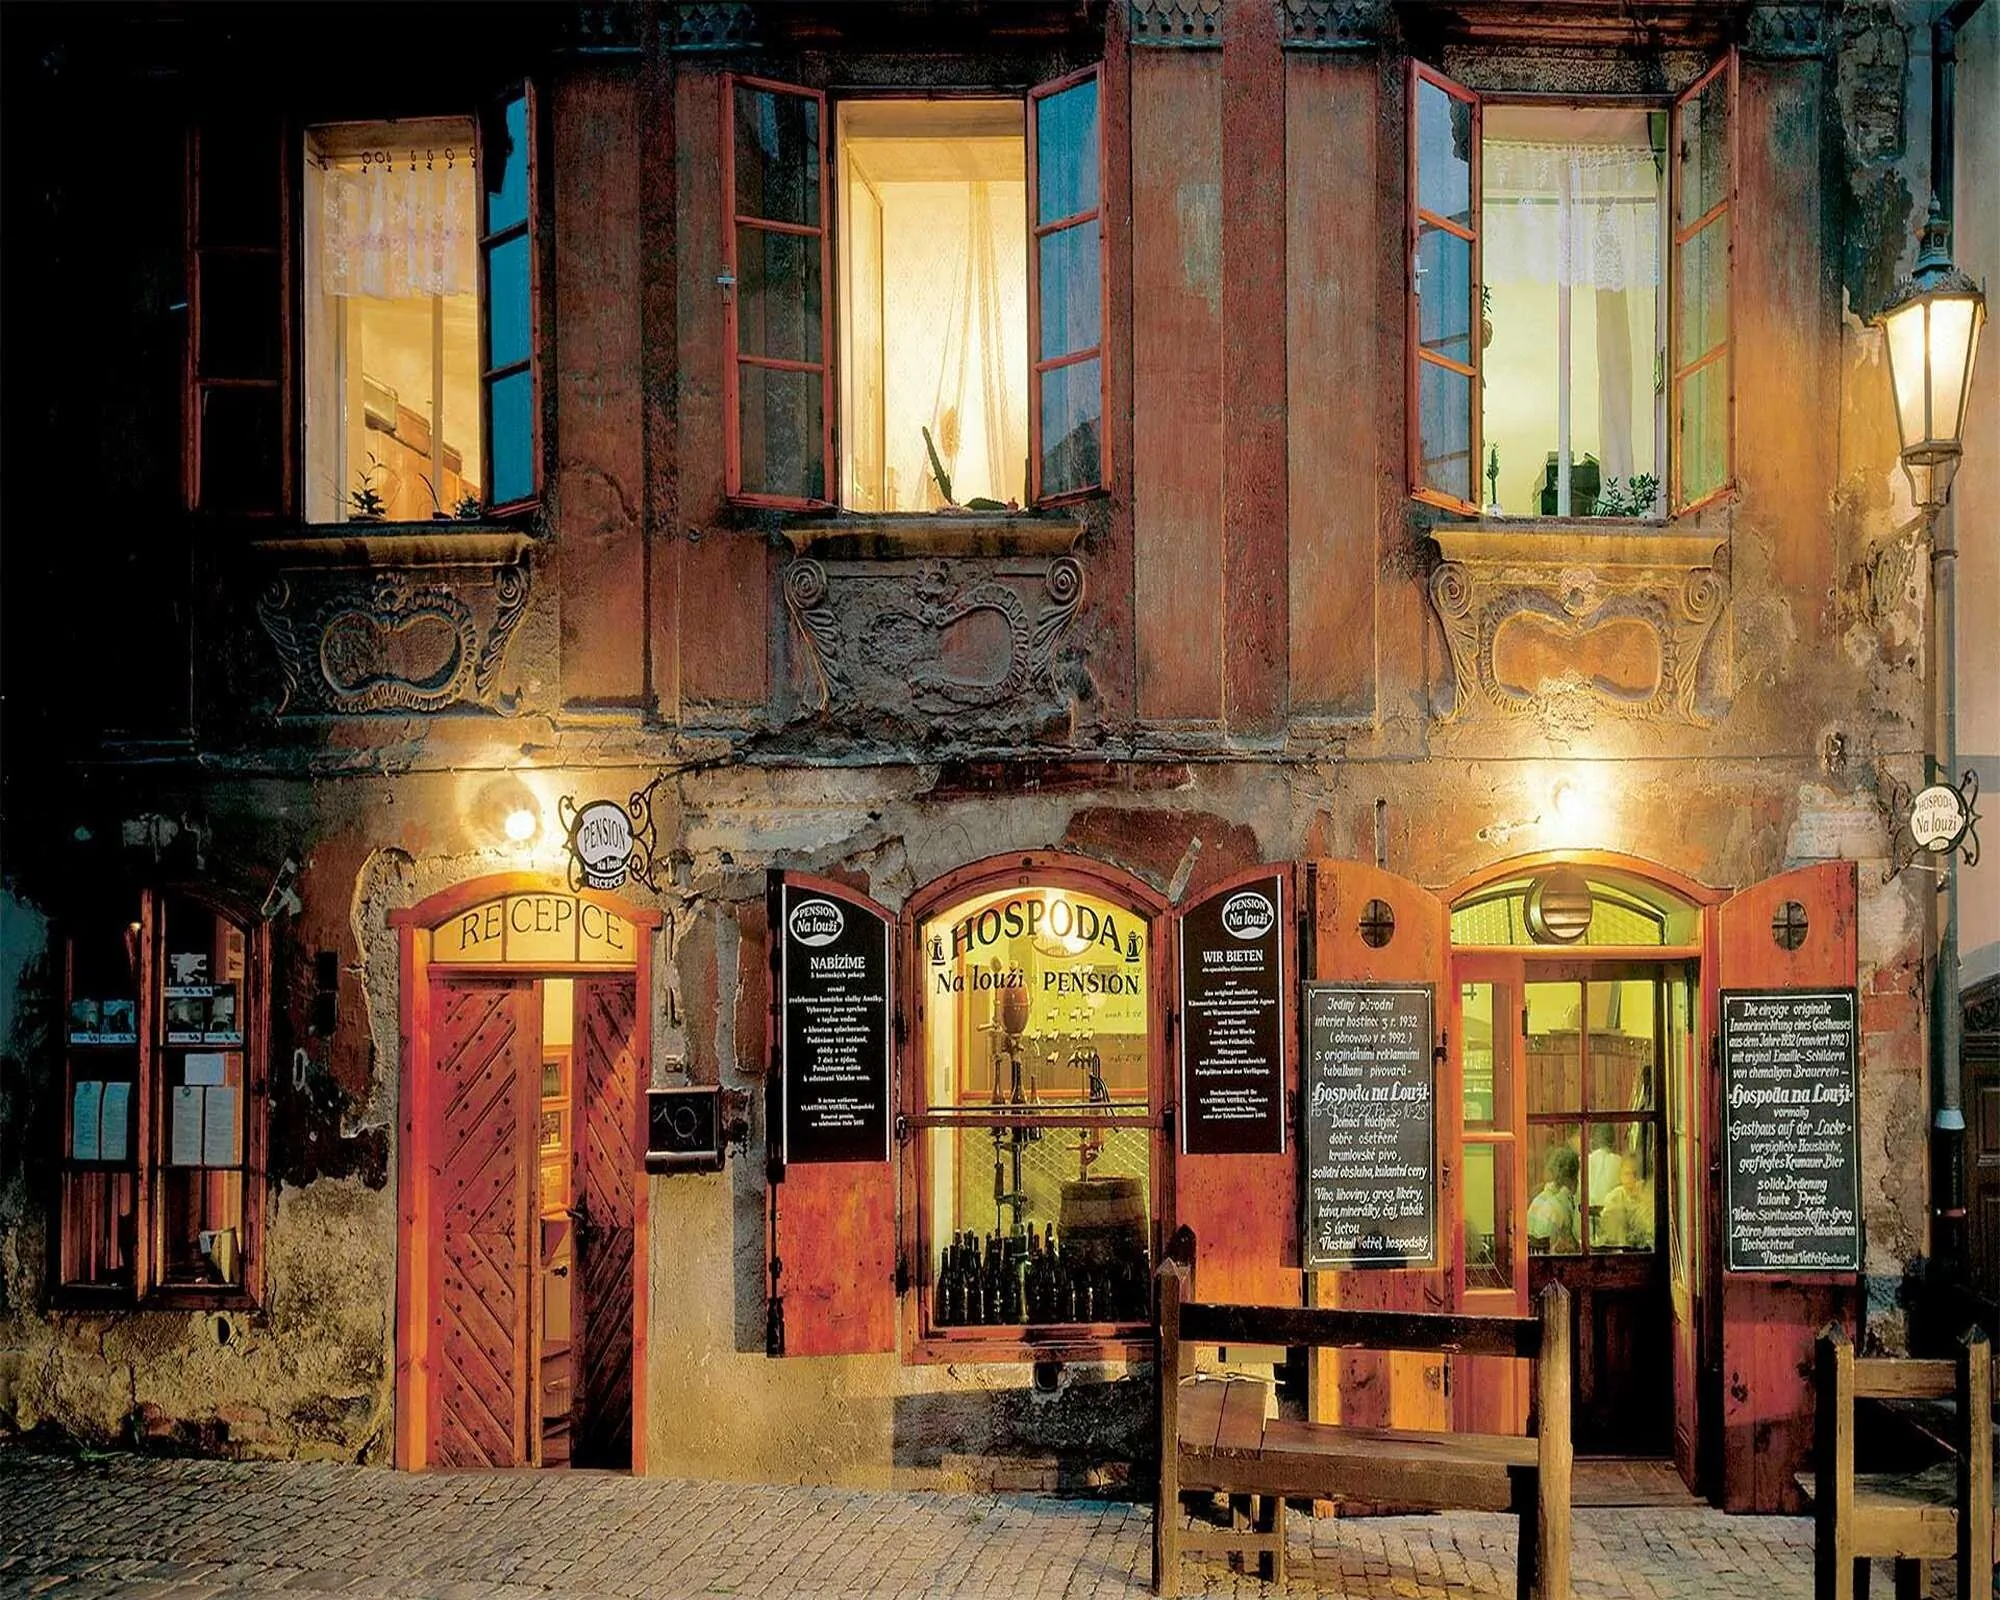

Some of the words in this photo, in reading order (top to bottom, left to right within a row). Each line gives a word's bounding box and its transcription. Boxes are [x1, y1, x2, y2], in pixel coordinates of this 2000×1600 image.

[1917, 816, 1928, 834] Na
[584, 818, 625, 852] PENSION
[799, 906, 835, 918] PENSION
[1232, 898, 1266, 911] PENSION
[797, 920, 811, 933] Na
[813, 917, 837, 932] louži
[1229, 913, 1242, 926] Na
[1245, 911, 1267, 925] louži
[950, 899, 1122, 960] HOSPODA
[811, 954, 865, 970] NABÍZÍME
[1203, 951, 1223, 963] WIR
[1227, 950, 1263, 962] BIETEN
[937, 970, 964, 994] Na
[973, 965, 1024, 991] louži
[1044, 972, 1139, 995] PENSION
[1328, 997, 1355, 1012] Jediný
[1744, 1002, 1758, 1017] Die
[1793, 1001, 1832, 1019] originale
[1400, 1016, 1418, 1028] 1932
[1794, 1019, 1811, 1030] eines
[1729, 1038, 1743, 1047] aus
[1743, 1035, 1759, 1047] dem
[1316, 1050, 1321, 1060] s
[1732, 1052, 1744, 1062] mit
[1745, 1050, 1771, 1066] original
[1733, 1068, 1747, 1078] von
[1749, 1065, 1792, 1081] ehemaligen
[1372, 1087, 1388, 1100] na
[1791, 1088, 1810, 1103] na
[1773, 1106, 1809, 1119] vormalig
[1329, 1131, 1353, 1144] dobře
[1359, 1130, 1399, 1144] ošetřené
[1778, 1120, 1796, 1139] auf
[1796, 1120, 1813, 1135] der
[1329, 1147, 1376, 1161] krumlovské
[1823, 1153, 1844, 1169] Bier
[1312, 1164, 1340, 1179] solidní
[1408, 1167, 1427, 1180] ceny
[1757, 1177, 1785, 1190] solide
[1372, 1190, 1395, 1203] grog,
[1397, 1186, 1424, 1202] likéry,
[1757, 1192, 1790, 1206] kulante
[1794, 1190, 1826, 1208] Preise
[1383, 1204, 1398, 1220] čaj,
[1400, 1202, 1424, 1216] tabák
[1323, 1222, 1331, 1235] S
[1335, 1221, 1360, 1235] úctou
[1319, 1236, 1356, 1250] Vlastimil
[1386, 1235, 1429, 1251] hospodský
[1742, 1238, 1794, 1252] Hochachtend
[1761, 1250, 1799, 1264] Vlastimil
